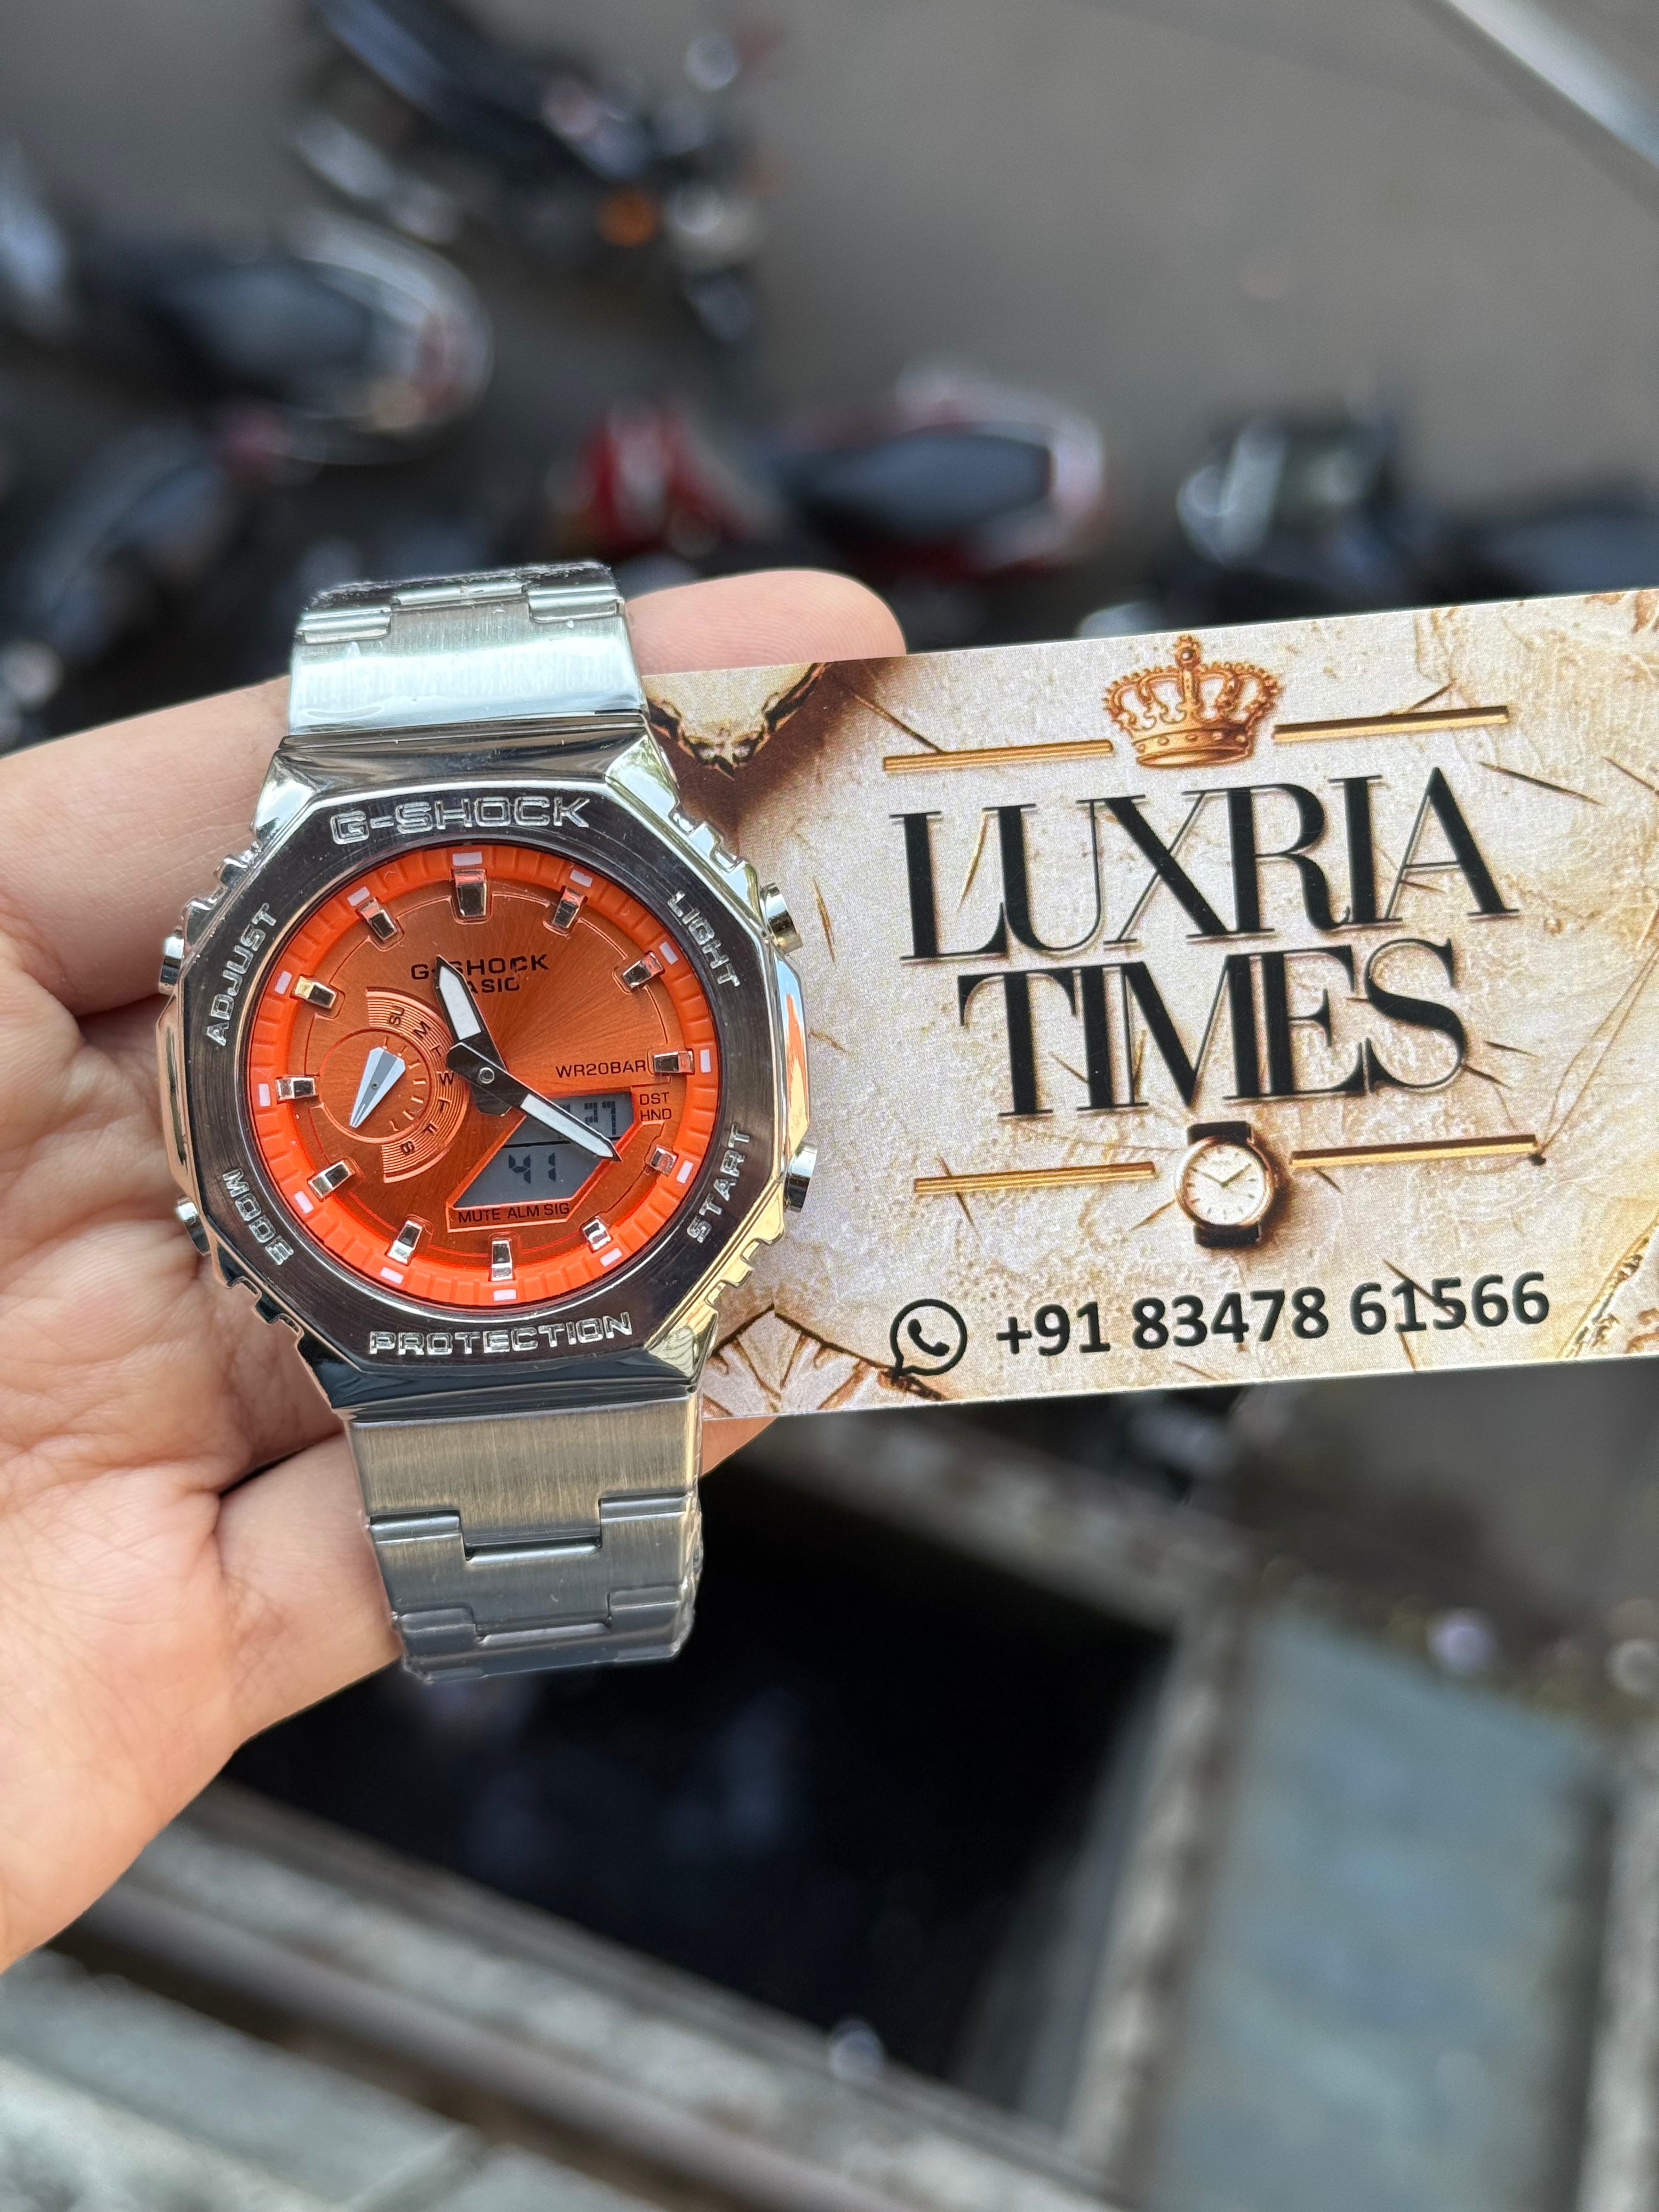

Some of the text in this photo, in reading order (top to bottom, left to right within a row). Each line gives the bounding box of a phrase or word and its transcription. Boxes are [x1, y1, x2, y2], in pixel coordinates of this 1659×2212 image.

[331, 796, 590, 845] G-SHOCK
[889, 768, 1520, 961] LUXRIA
[667, 890, 740, 987] LIGHT
[206, 902, 276, 1047] ADJUST
[411, 954, 549, 980] GSHOCK
[389, 1005, 405, 1026] SU
[413, 1020, 431, 1039] M
[958, 938, 1467, 1117] TIMES
[430, 1045, 442, 1058] T
[439, 1071, 454, 1086] W
[555, 1060, 646, 1079] WR20BAR
[439, 1097, 451, 1112] T
[640, 1092, 669, 1105] DST
[640, 1108, 672, 1122] HND
[508, 1152, 556, 1184] 41
[686, 1124, 750, 1243] START
[222, 1168, 294, 1265] MODE
[458, 1202, 570, 1223] MUTE ALM SIG
[996, 1272, 1550, 1357] +91 83478 61566
[369, 1311, 633, 1356] PROTECTION
